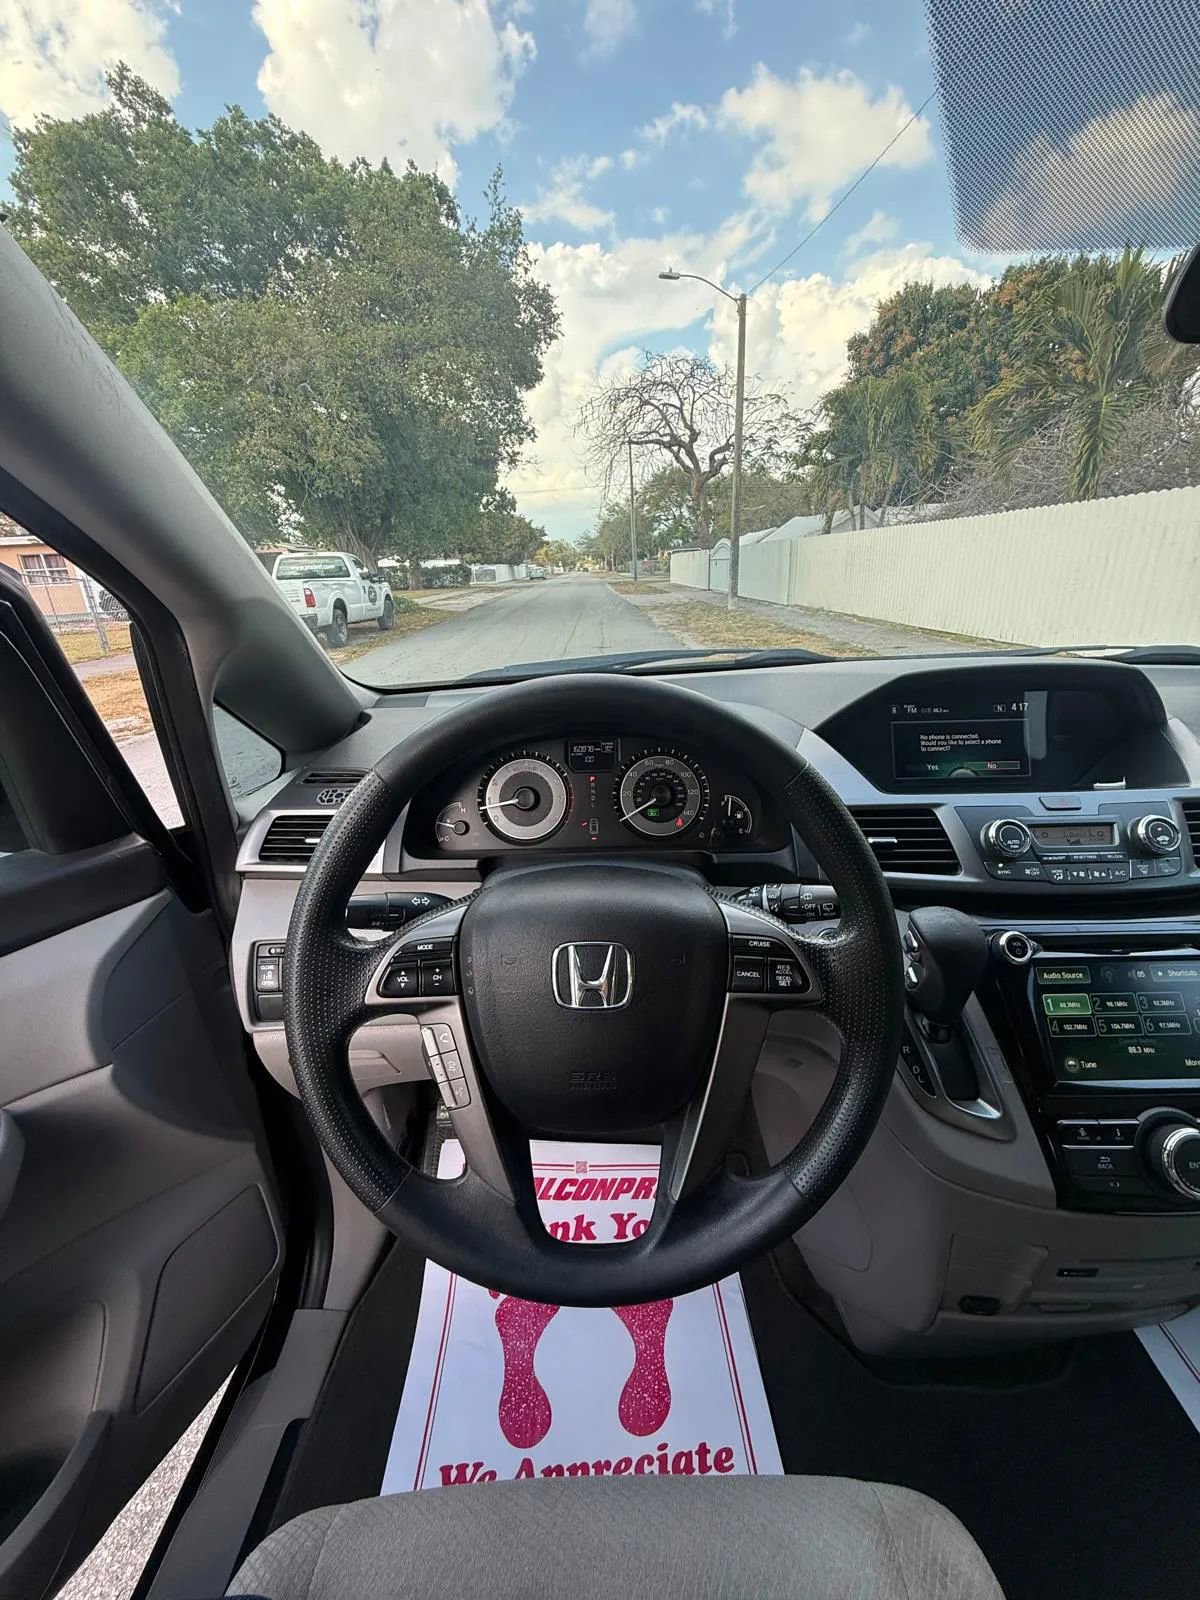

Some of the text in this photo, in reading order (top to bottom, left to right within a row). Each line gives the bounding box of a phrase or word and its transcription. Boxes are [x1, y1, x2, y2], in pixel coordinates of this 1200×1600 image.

[1062, 971, 1083, 979] Source
[1168, 969, 1198, 977] Shortcuts
[1093, 997, 1102, 1010] 2
[1141, 997, 1149, 1009] 3
[1052, 1020, 1060, 1033] 4
[1099, 1019, 1107, 1032] 5
[1146, 1019, 1154, 1032] 6
[1080, 1060, 1097, 1068] Tune
